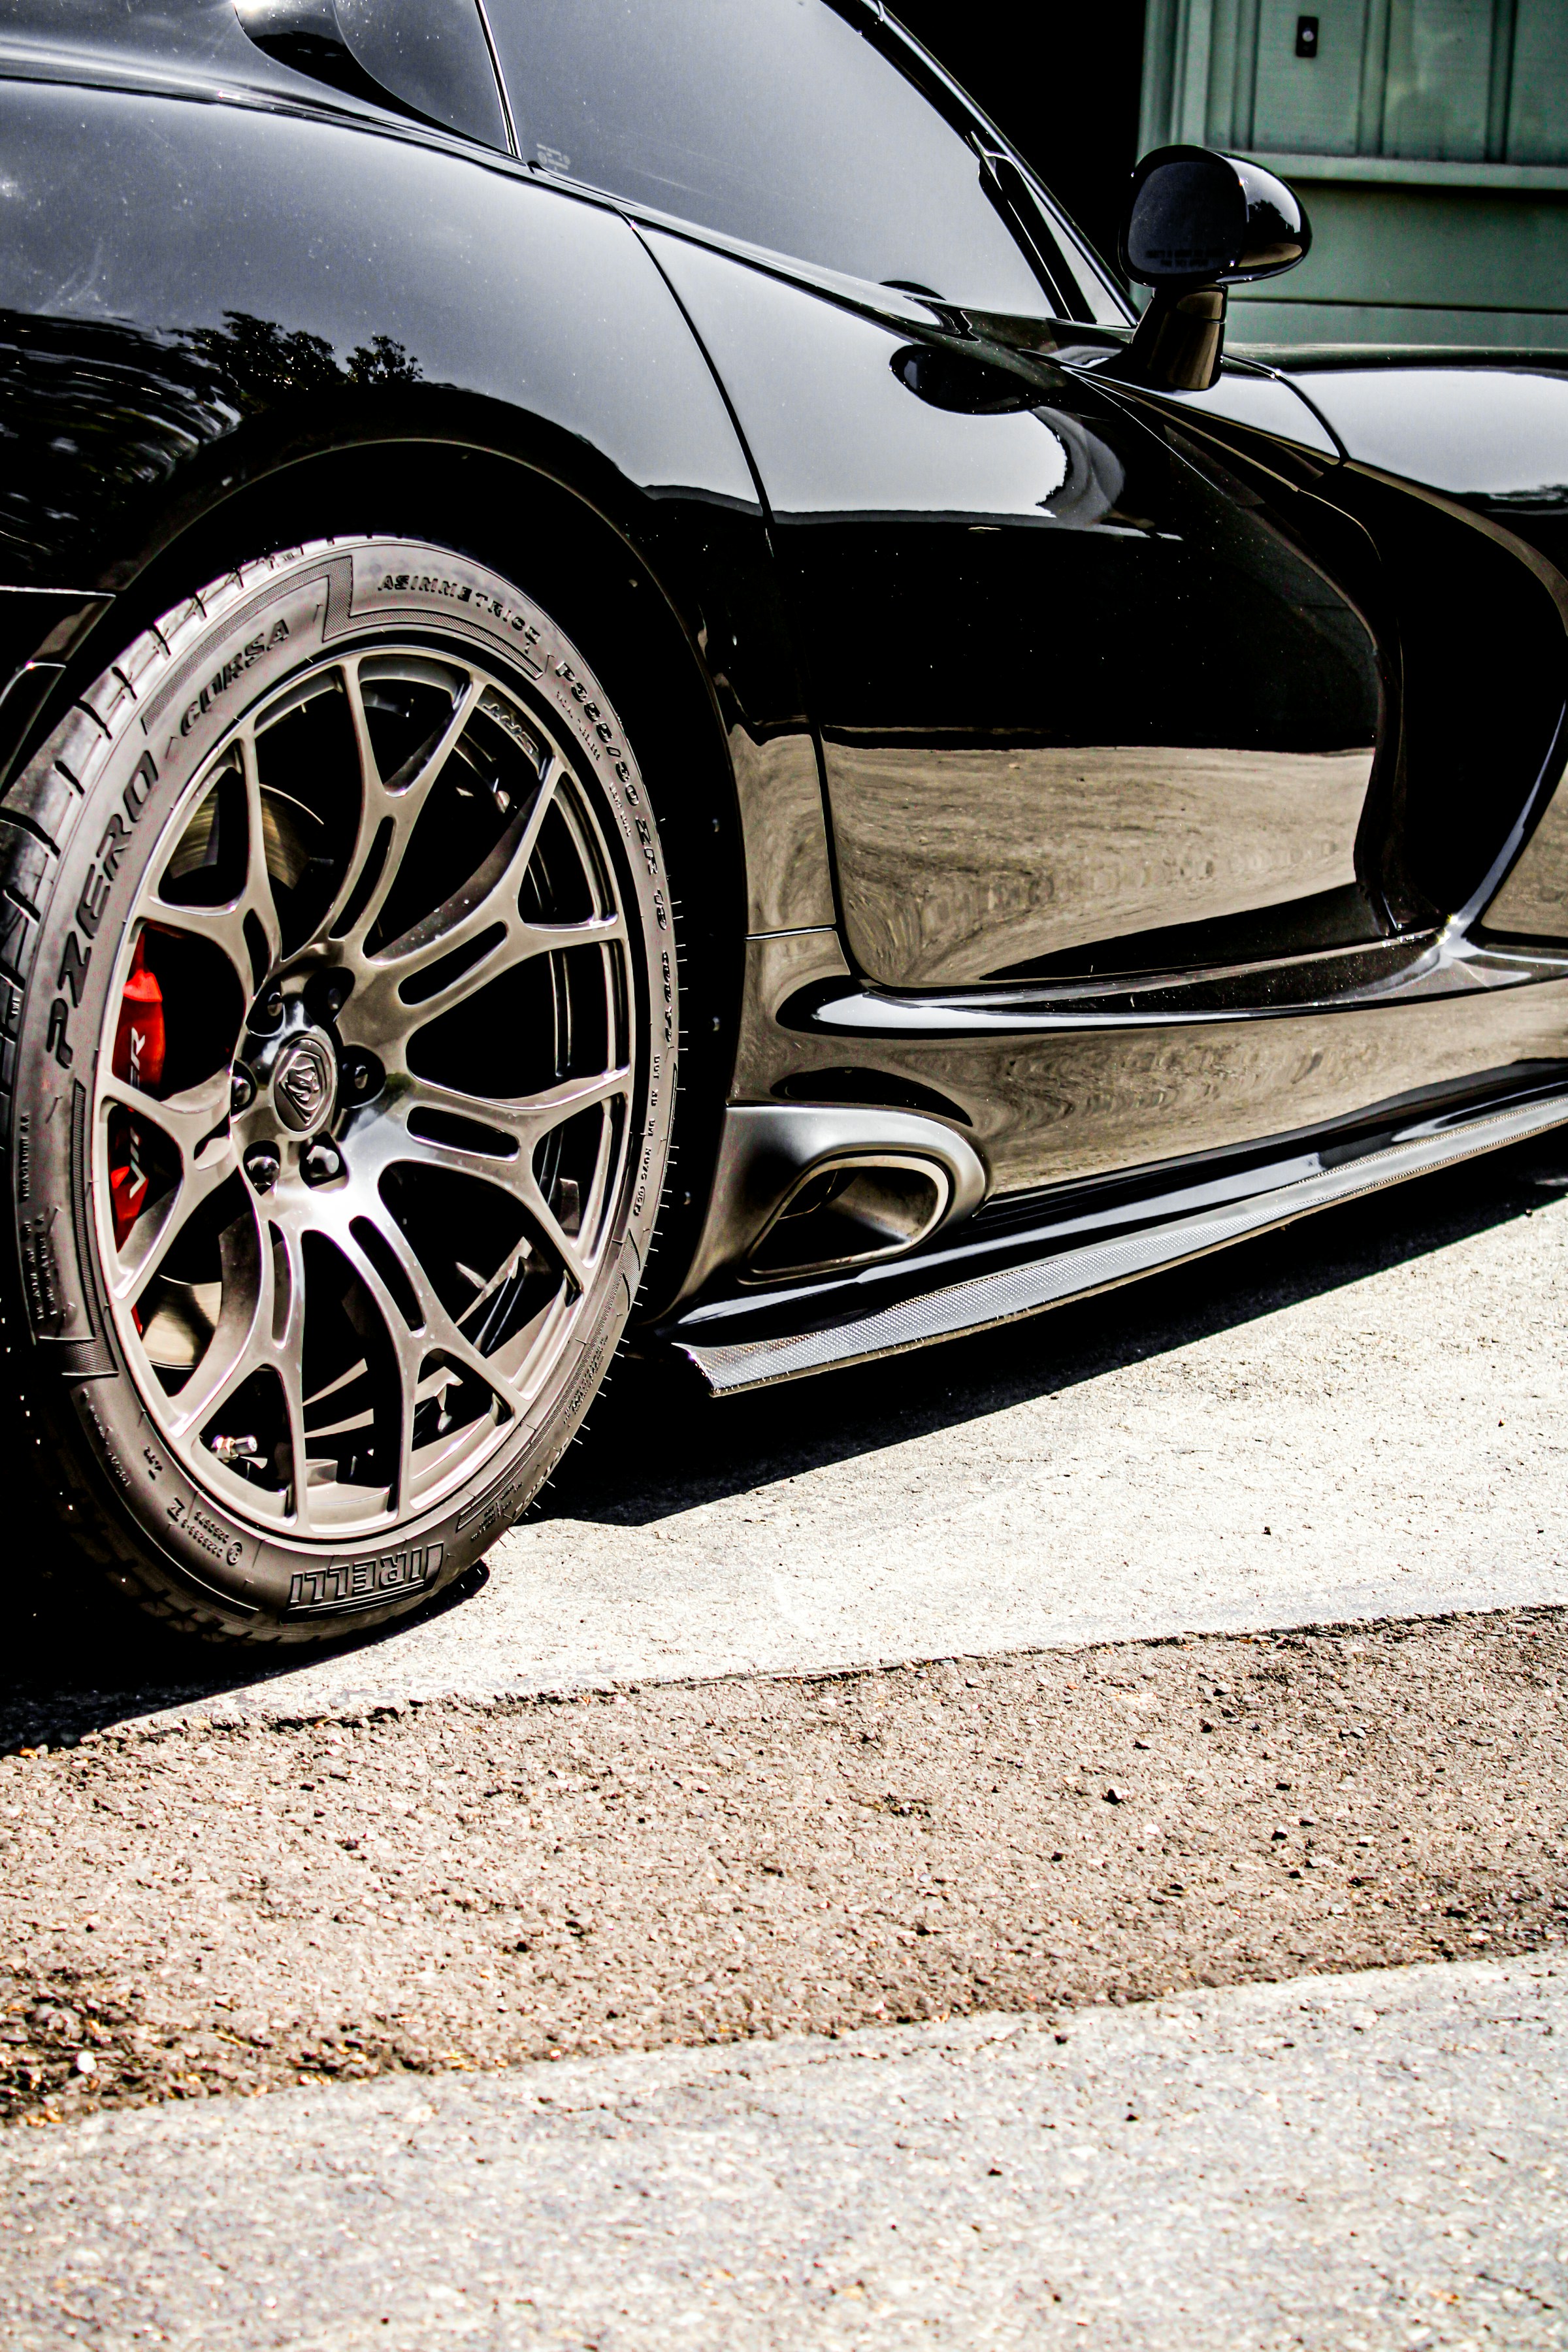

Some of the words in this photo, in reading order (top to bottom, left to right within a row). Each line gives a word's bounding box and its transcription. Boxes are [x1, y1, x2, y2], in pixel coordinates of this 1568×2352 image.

[181, 618, 289, 738] CORSA
[482, 703, 540, 754] SRT
[556, 661, 640, 806] P355/30
[635, 817, 658, 875] ZR
[285, 1541, 444, 1614] PIRELLI
